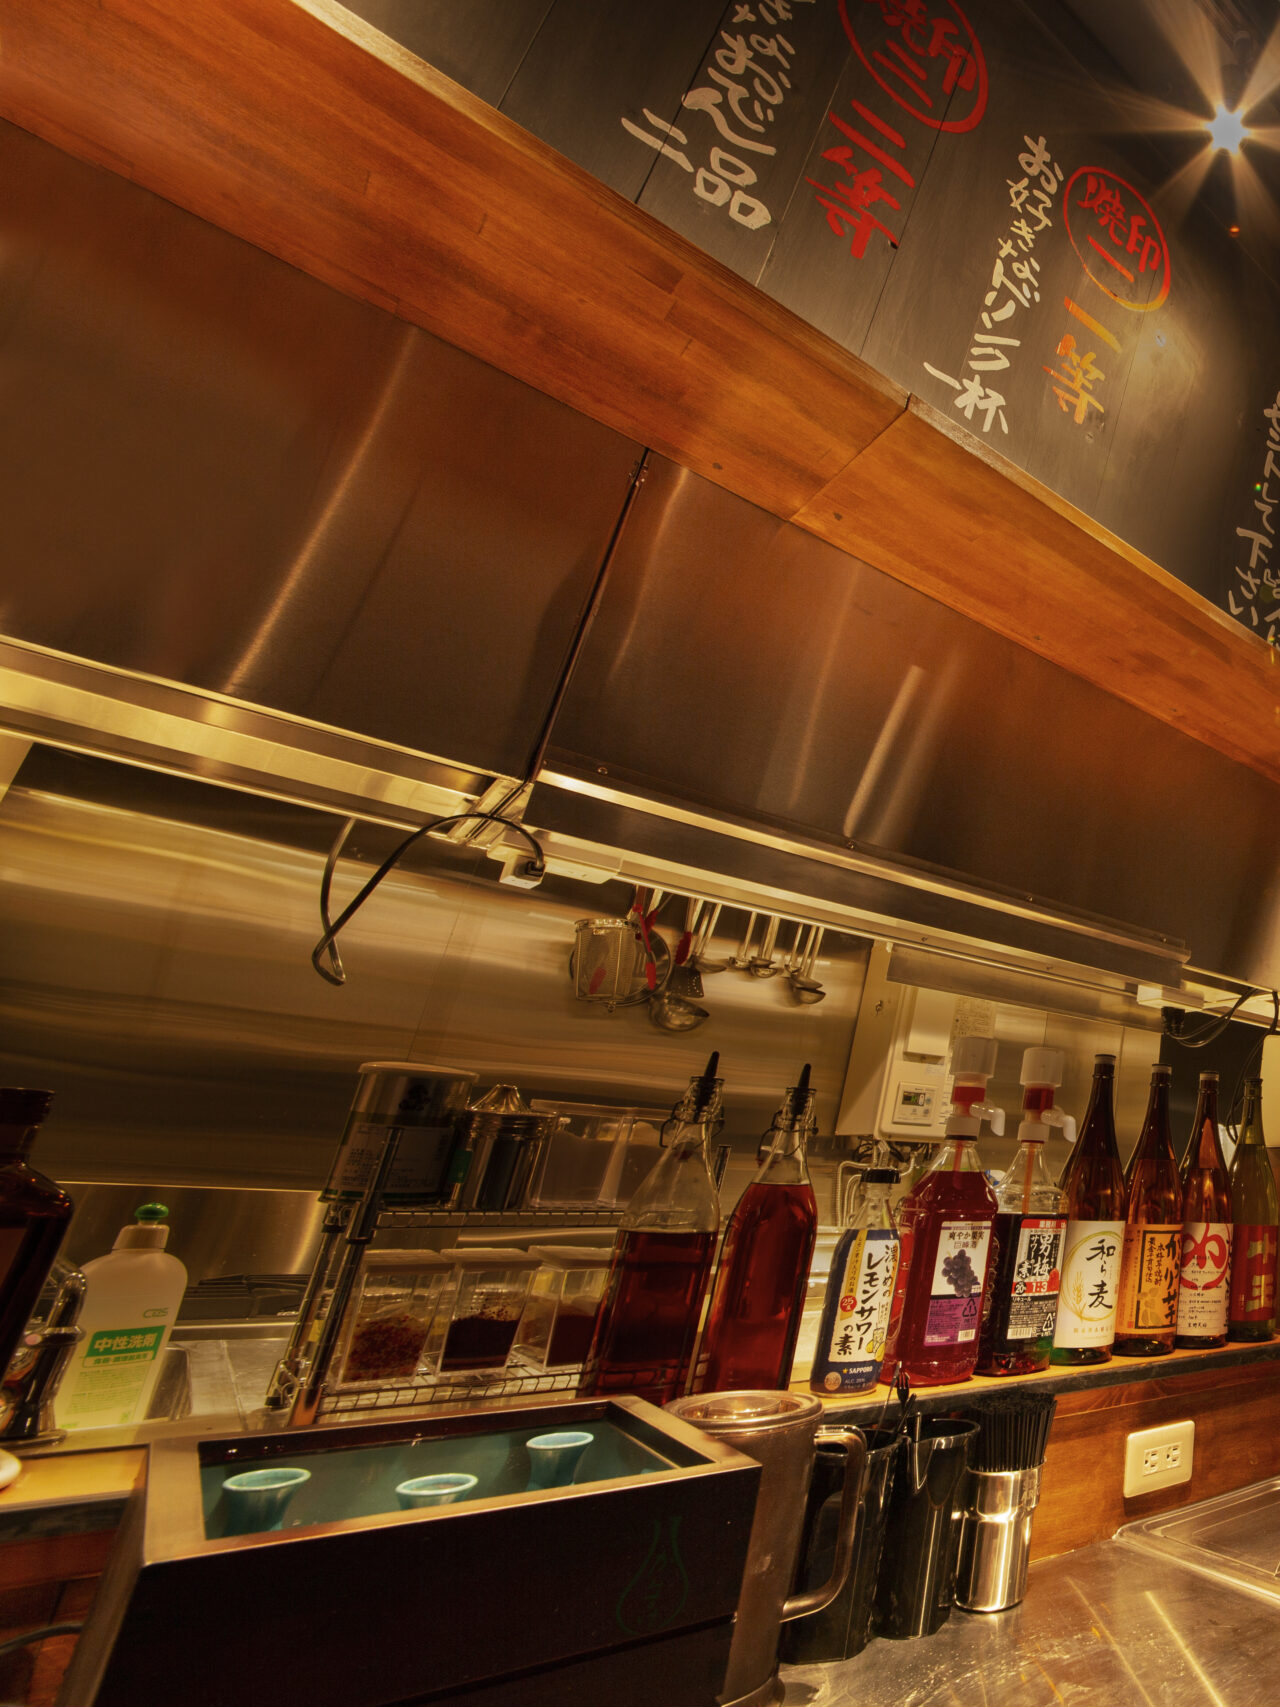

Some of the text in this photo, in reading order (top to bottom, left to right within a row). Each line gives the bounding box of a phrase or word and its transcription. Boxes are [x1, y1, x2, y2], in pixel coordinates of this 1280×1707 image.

[621, 0, 800, 231] きなおでん二品
[1032, 1233, 1055, 1278] 男梅
[1085, 1238, 1117, 1310] 和ら麦
[855, 1252, 886, 1351] レモンサワー
[94, 1332, 158, 1353] 中性洗剤
[834, 1324, 855, 1356] の素
[848, 1365, 873, 1375] SAPPORO
